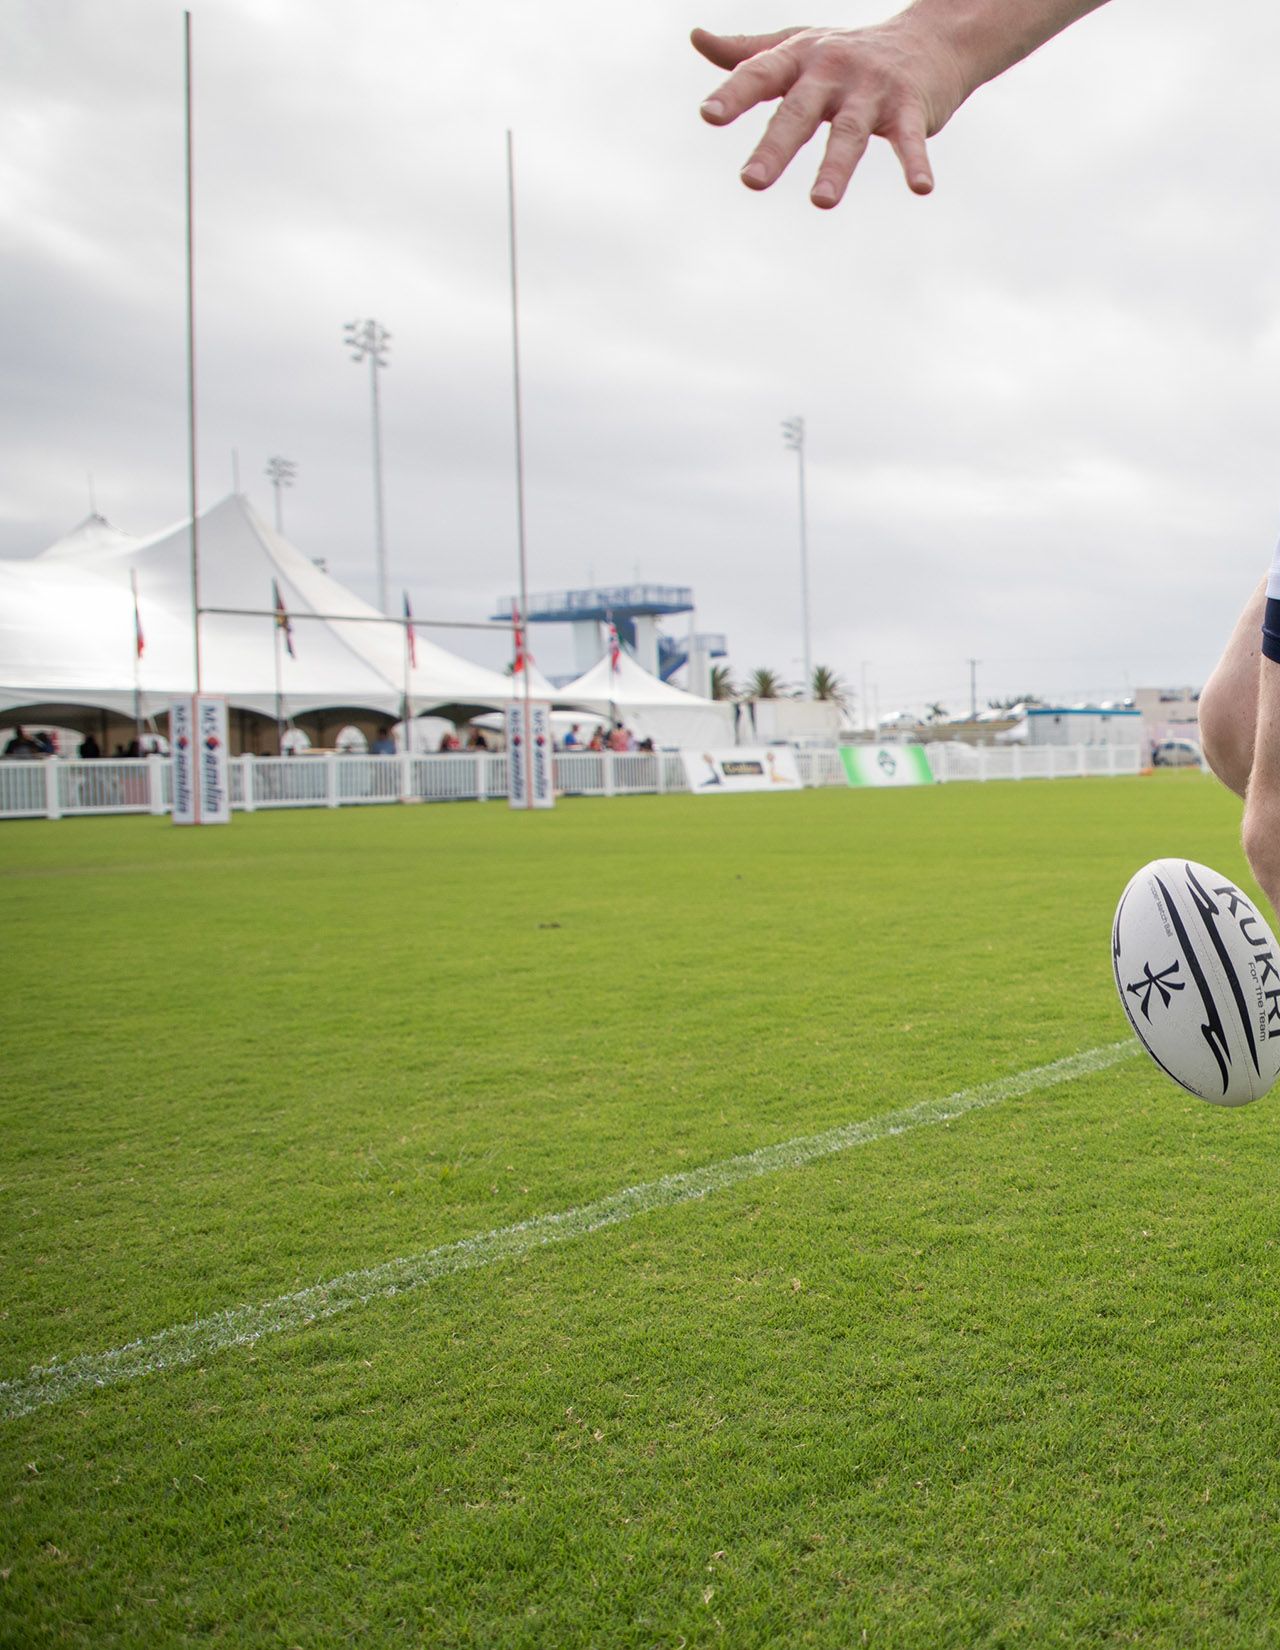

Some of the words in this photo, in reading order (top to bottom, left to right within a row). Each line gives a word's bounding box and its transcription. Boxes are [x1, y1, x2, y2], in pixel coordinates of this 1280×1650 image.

[206, 752, 222, 813] amlin
[1248, 962, 1258, 982] For
[1255, 985, 1264, 1008] The
